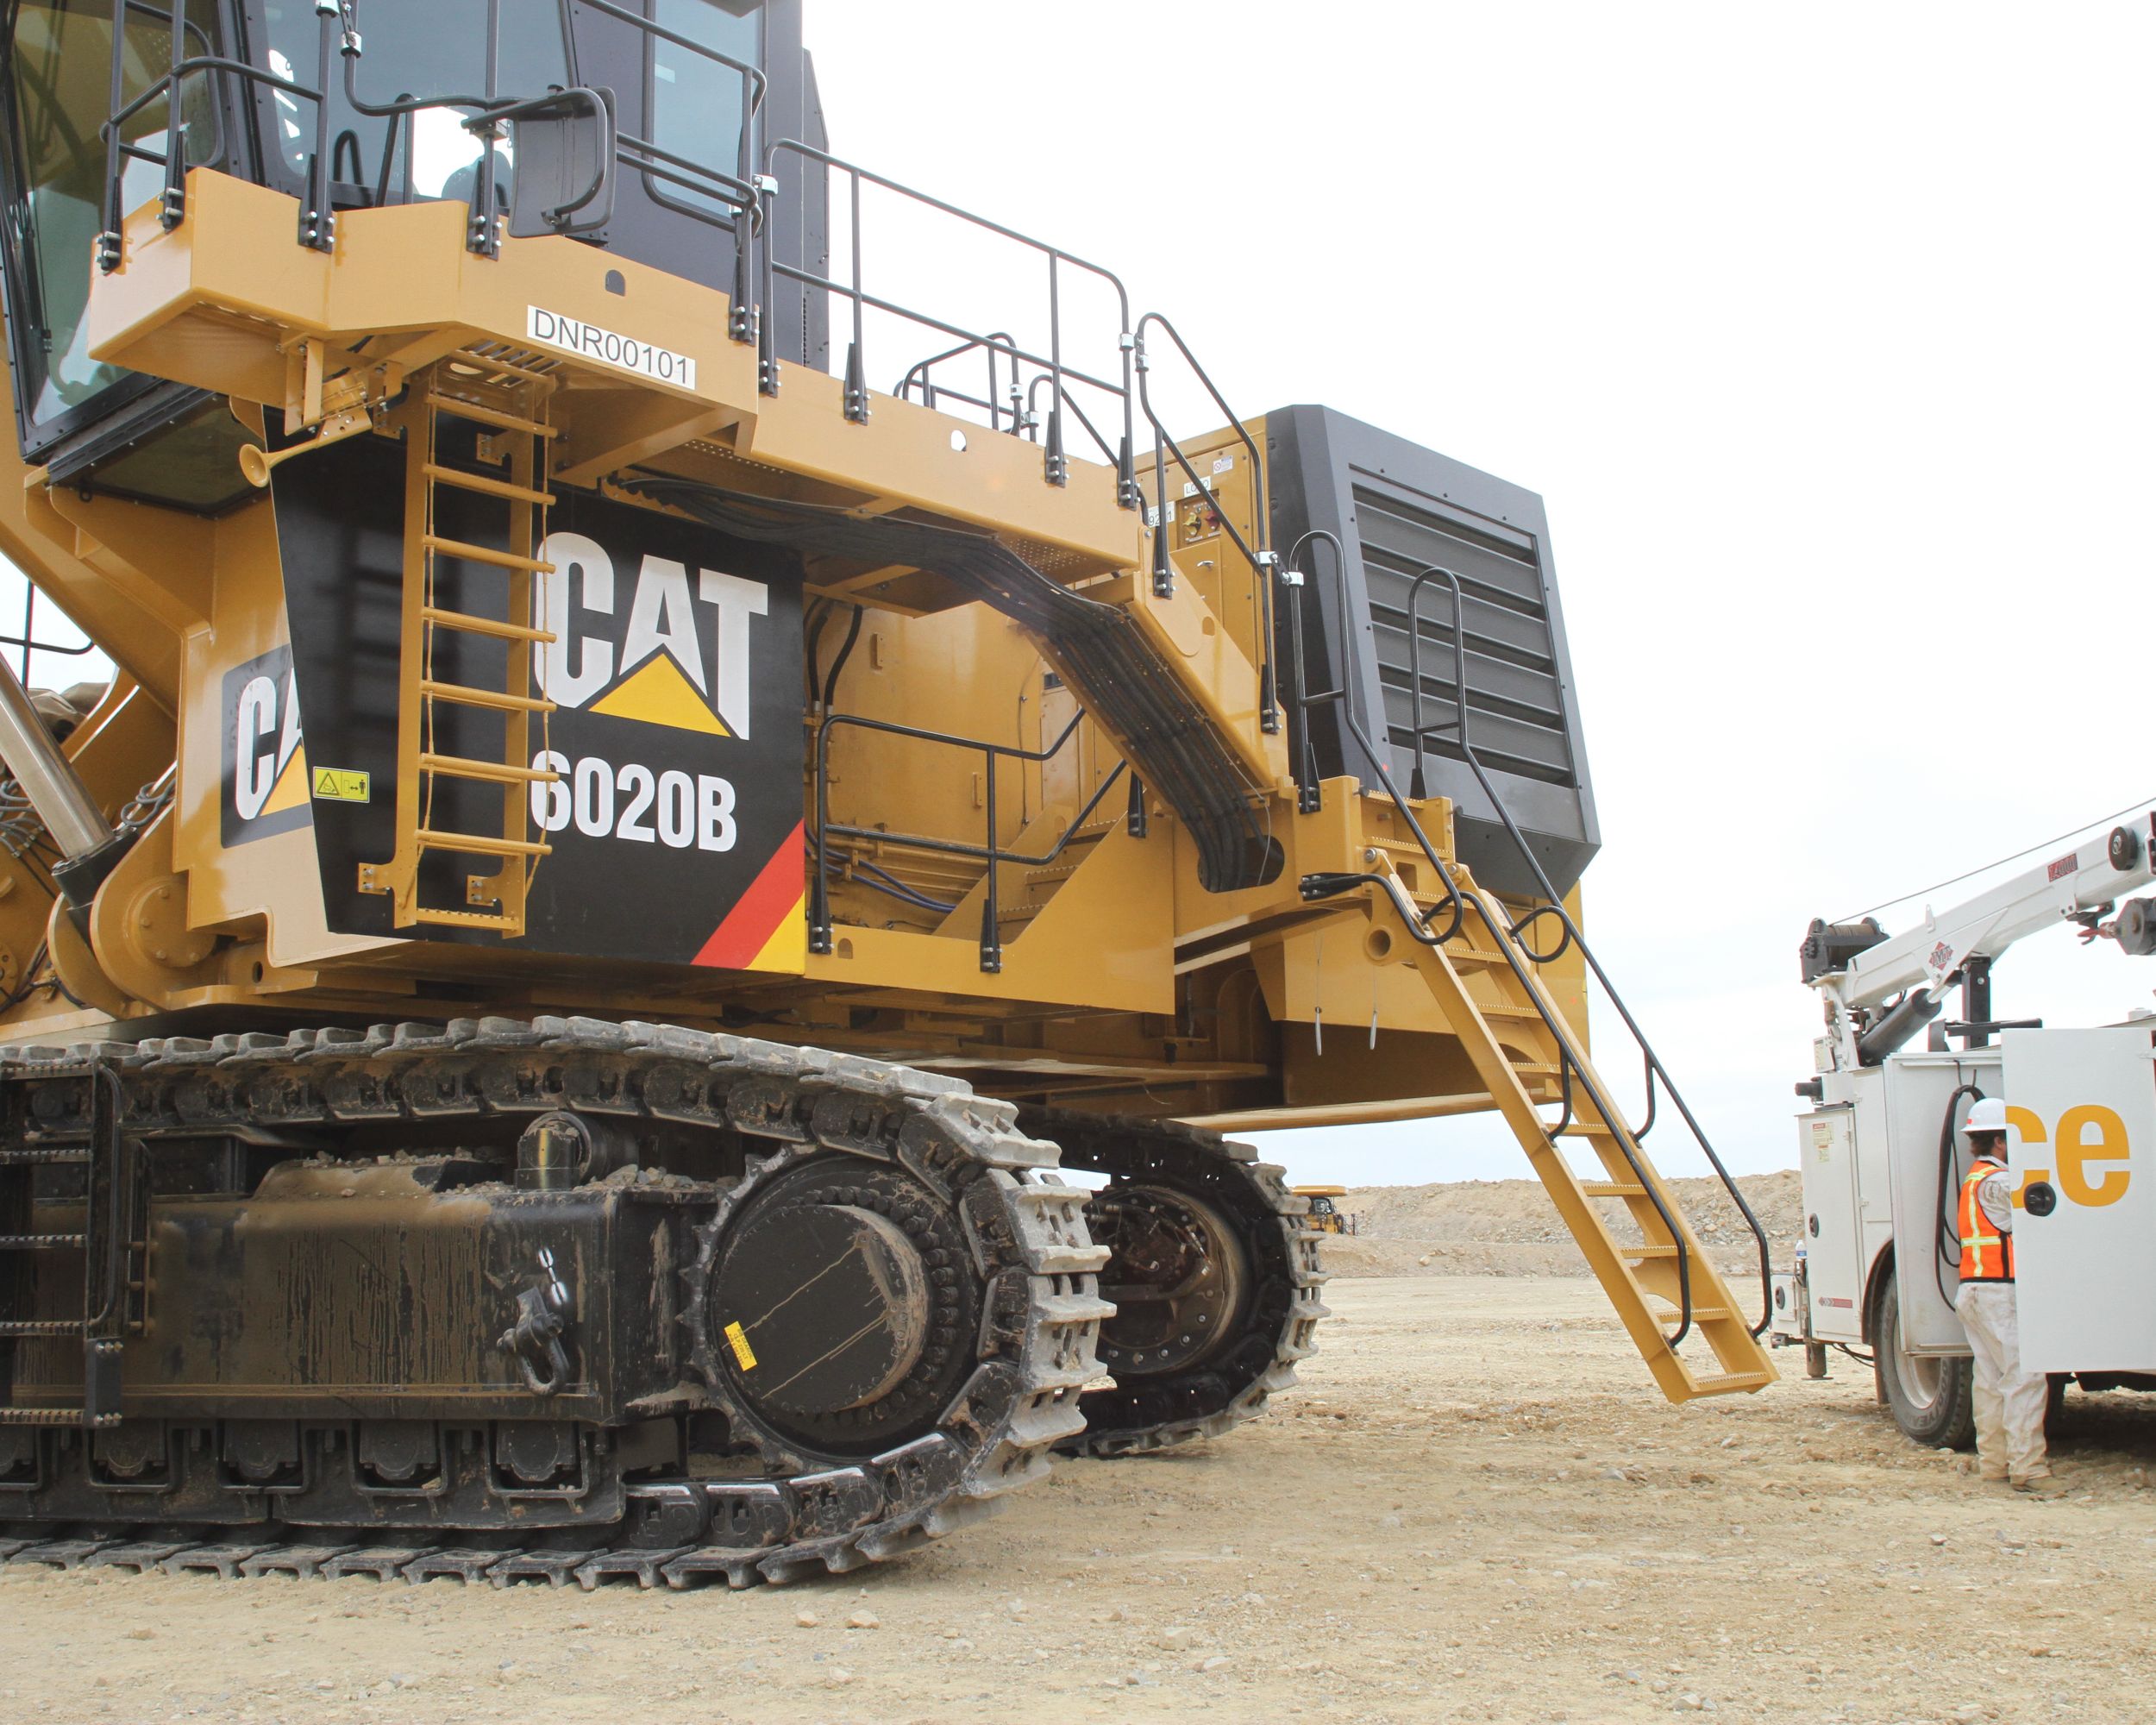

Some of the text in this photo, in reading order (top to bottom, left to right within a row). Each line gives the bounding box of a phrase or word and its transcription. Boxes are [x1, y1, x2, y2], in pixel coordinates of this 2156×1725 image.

[535, 309, 686, 384] DNR00101
[1149, 511, 1172, 526] 921
[1186, 480, 1209, 494] LOO
[535, 532, 768, 741] CAT
[530, 750, 737, 852] 6020B
